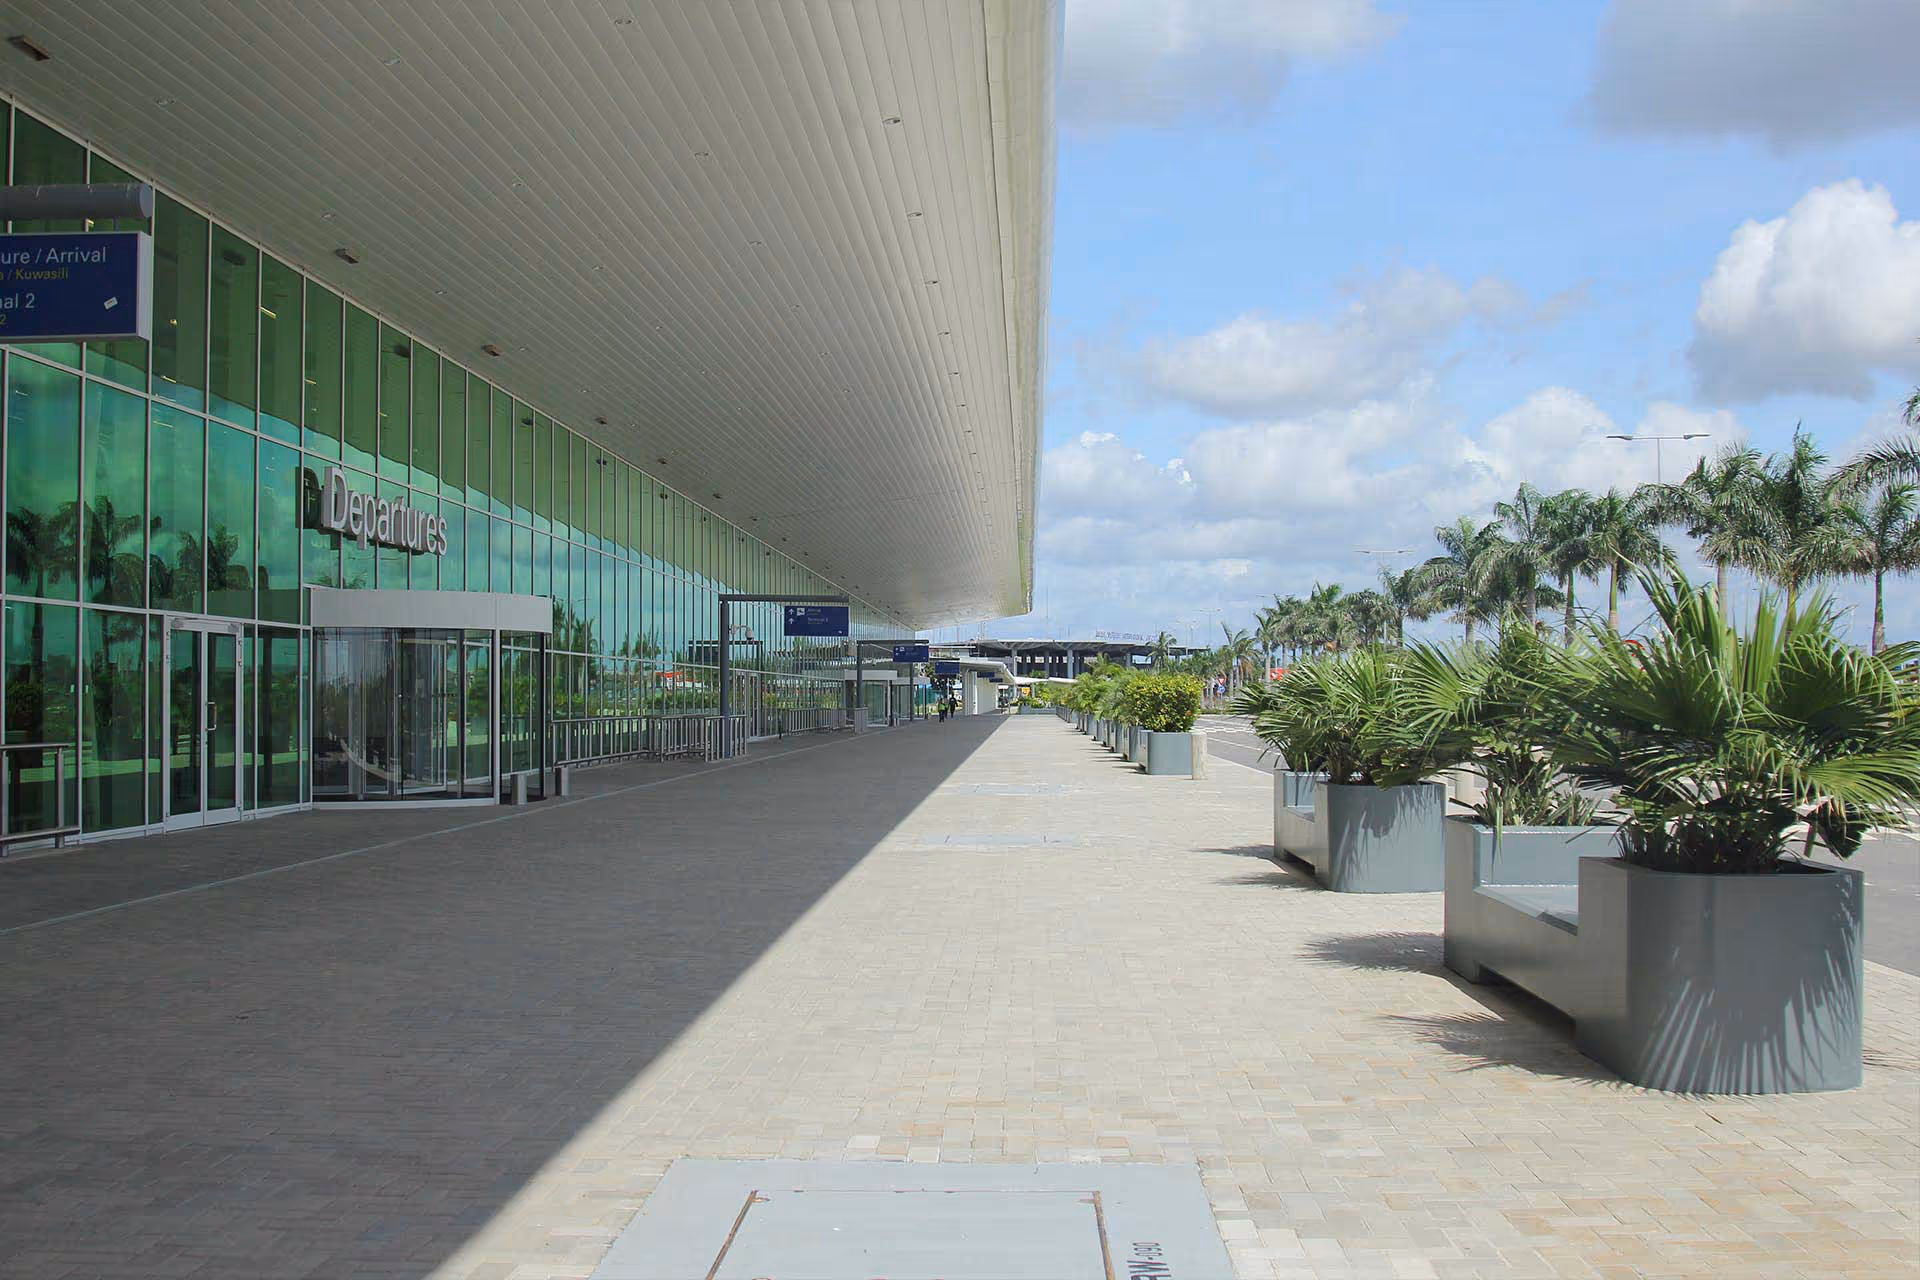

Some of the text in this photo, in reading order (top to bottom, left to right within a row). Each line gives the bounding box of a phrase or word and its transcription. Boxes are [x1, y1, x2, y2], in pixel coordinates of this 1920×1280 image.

[46, 246, 106, 264] Arrival
[16, 267, 69, 280] Kuwasili
[0, 292, 35, 309] al 2
[325, 466, 448, 556] Departures
